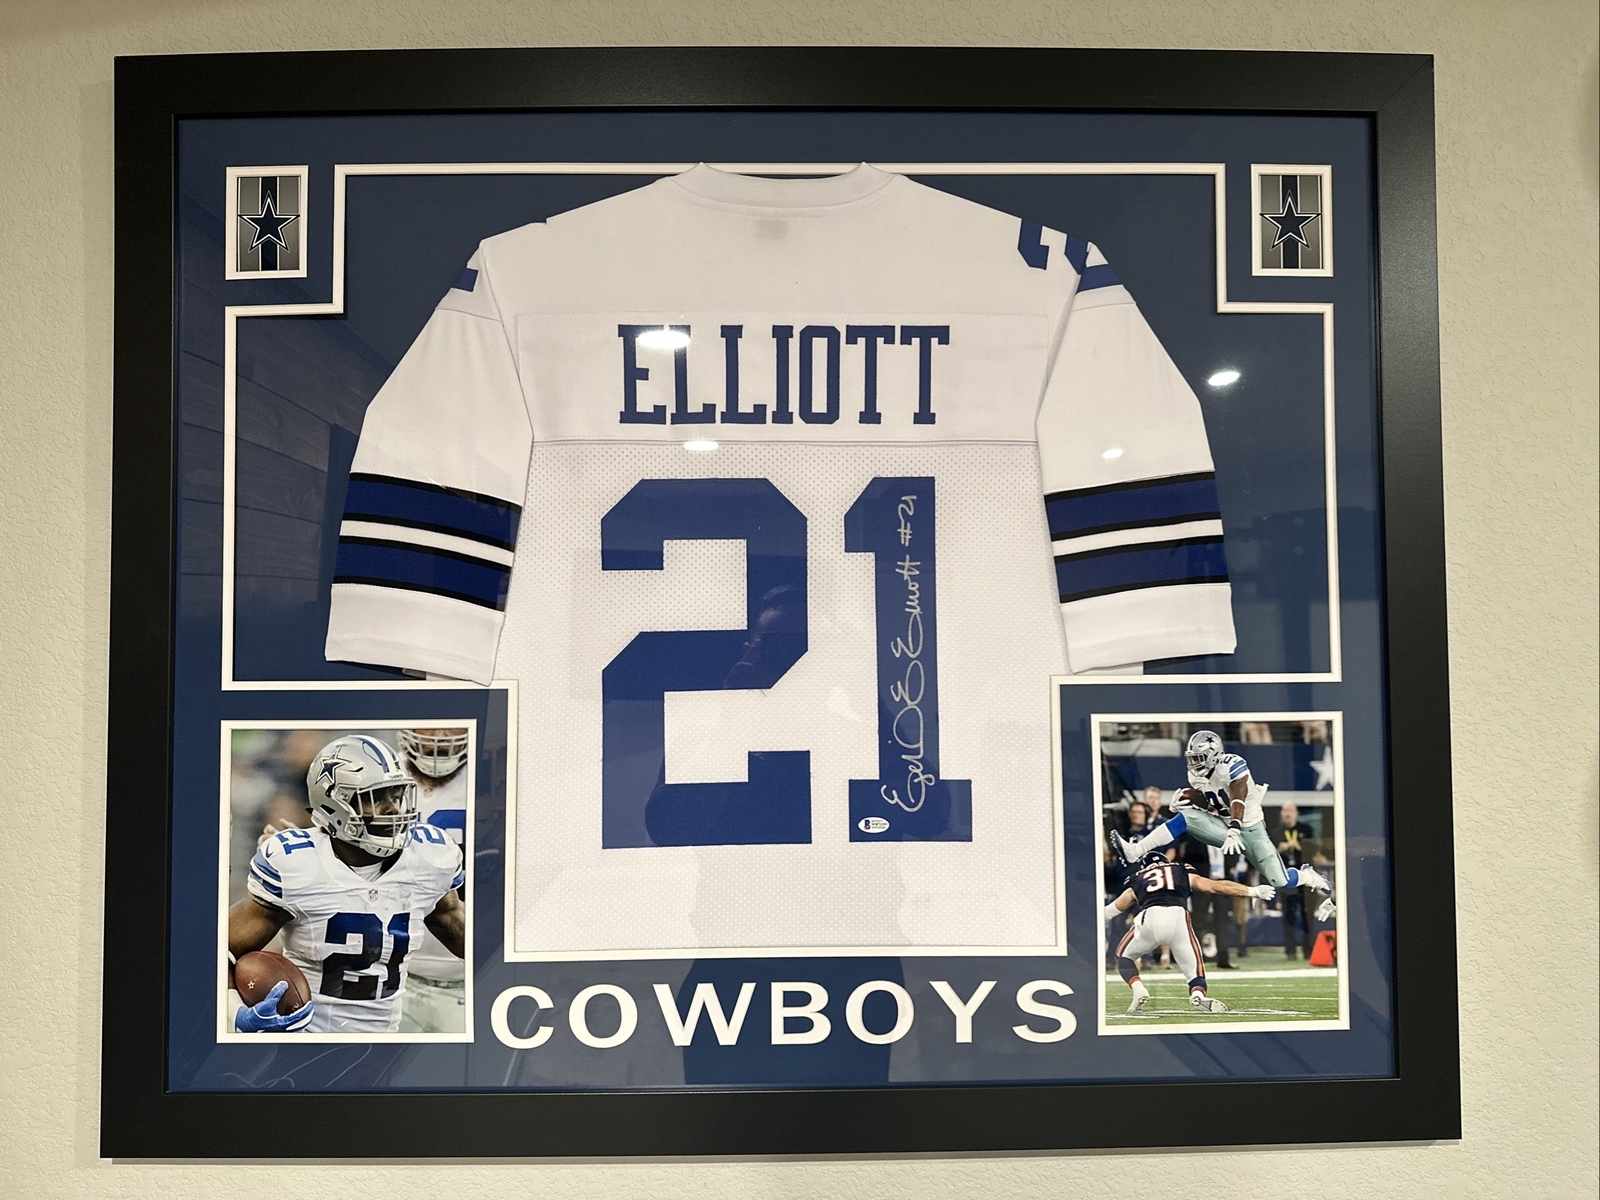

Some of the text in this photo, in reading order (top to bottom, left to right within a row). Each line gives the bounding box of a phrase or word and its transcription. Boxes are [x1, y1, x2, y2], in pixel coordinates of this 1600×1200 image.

[618, 324, 950, 425] ELLIOTT
[896, 494, 917, 547] #21
[600, 476, 973, 850] 21
[1143, 866, 1175, 893] 31
[319, 912, 410, 1000] 21
[490, 979, 1078, 1050] COWBOYS
